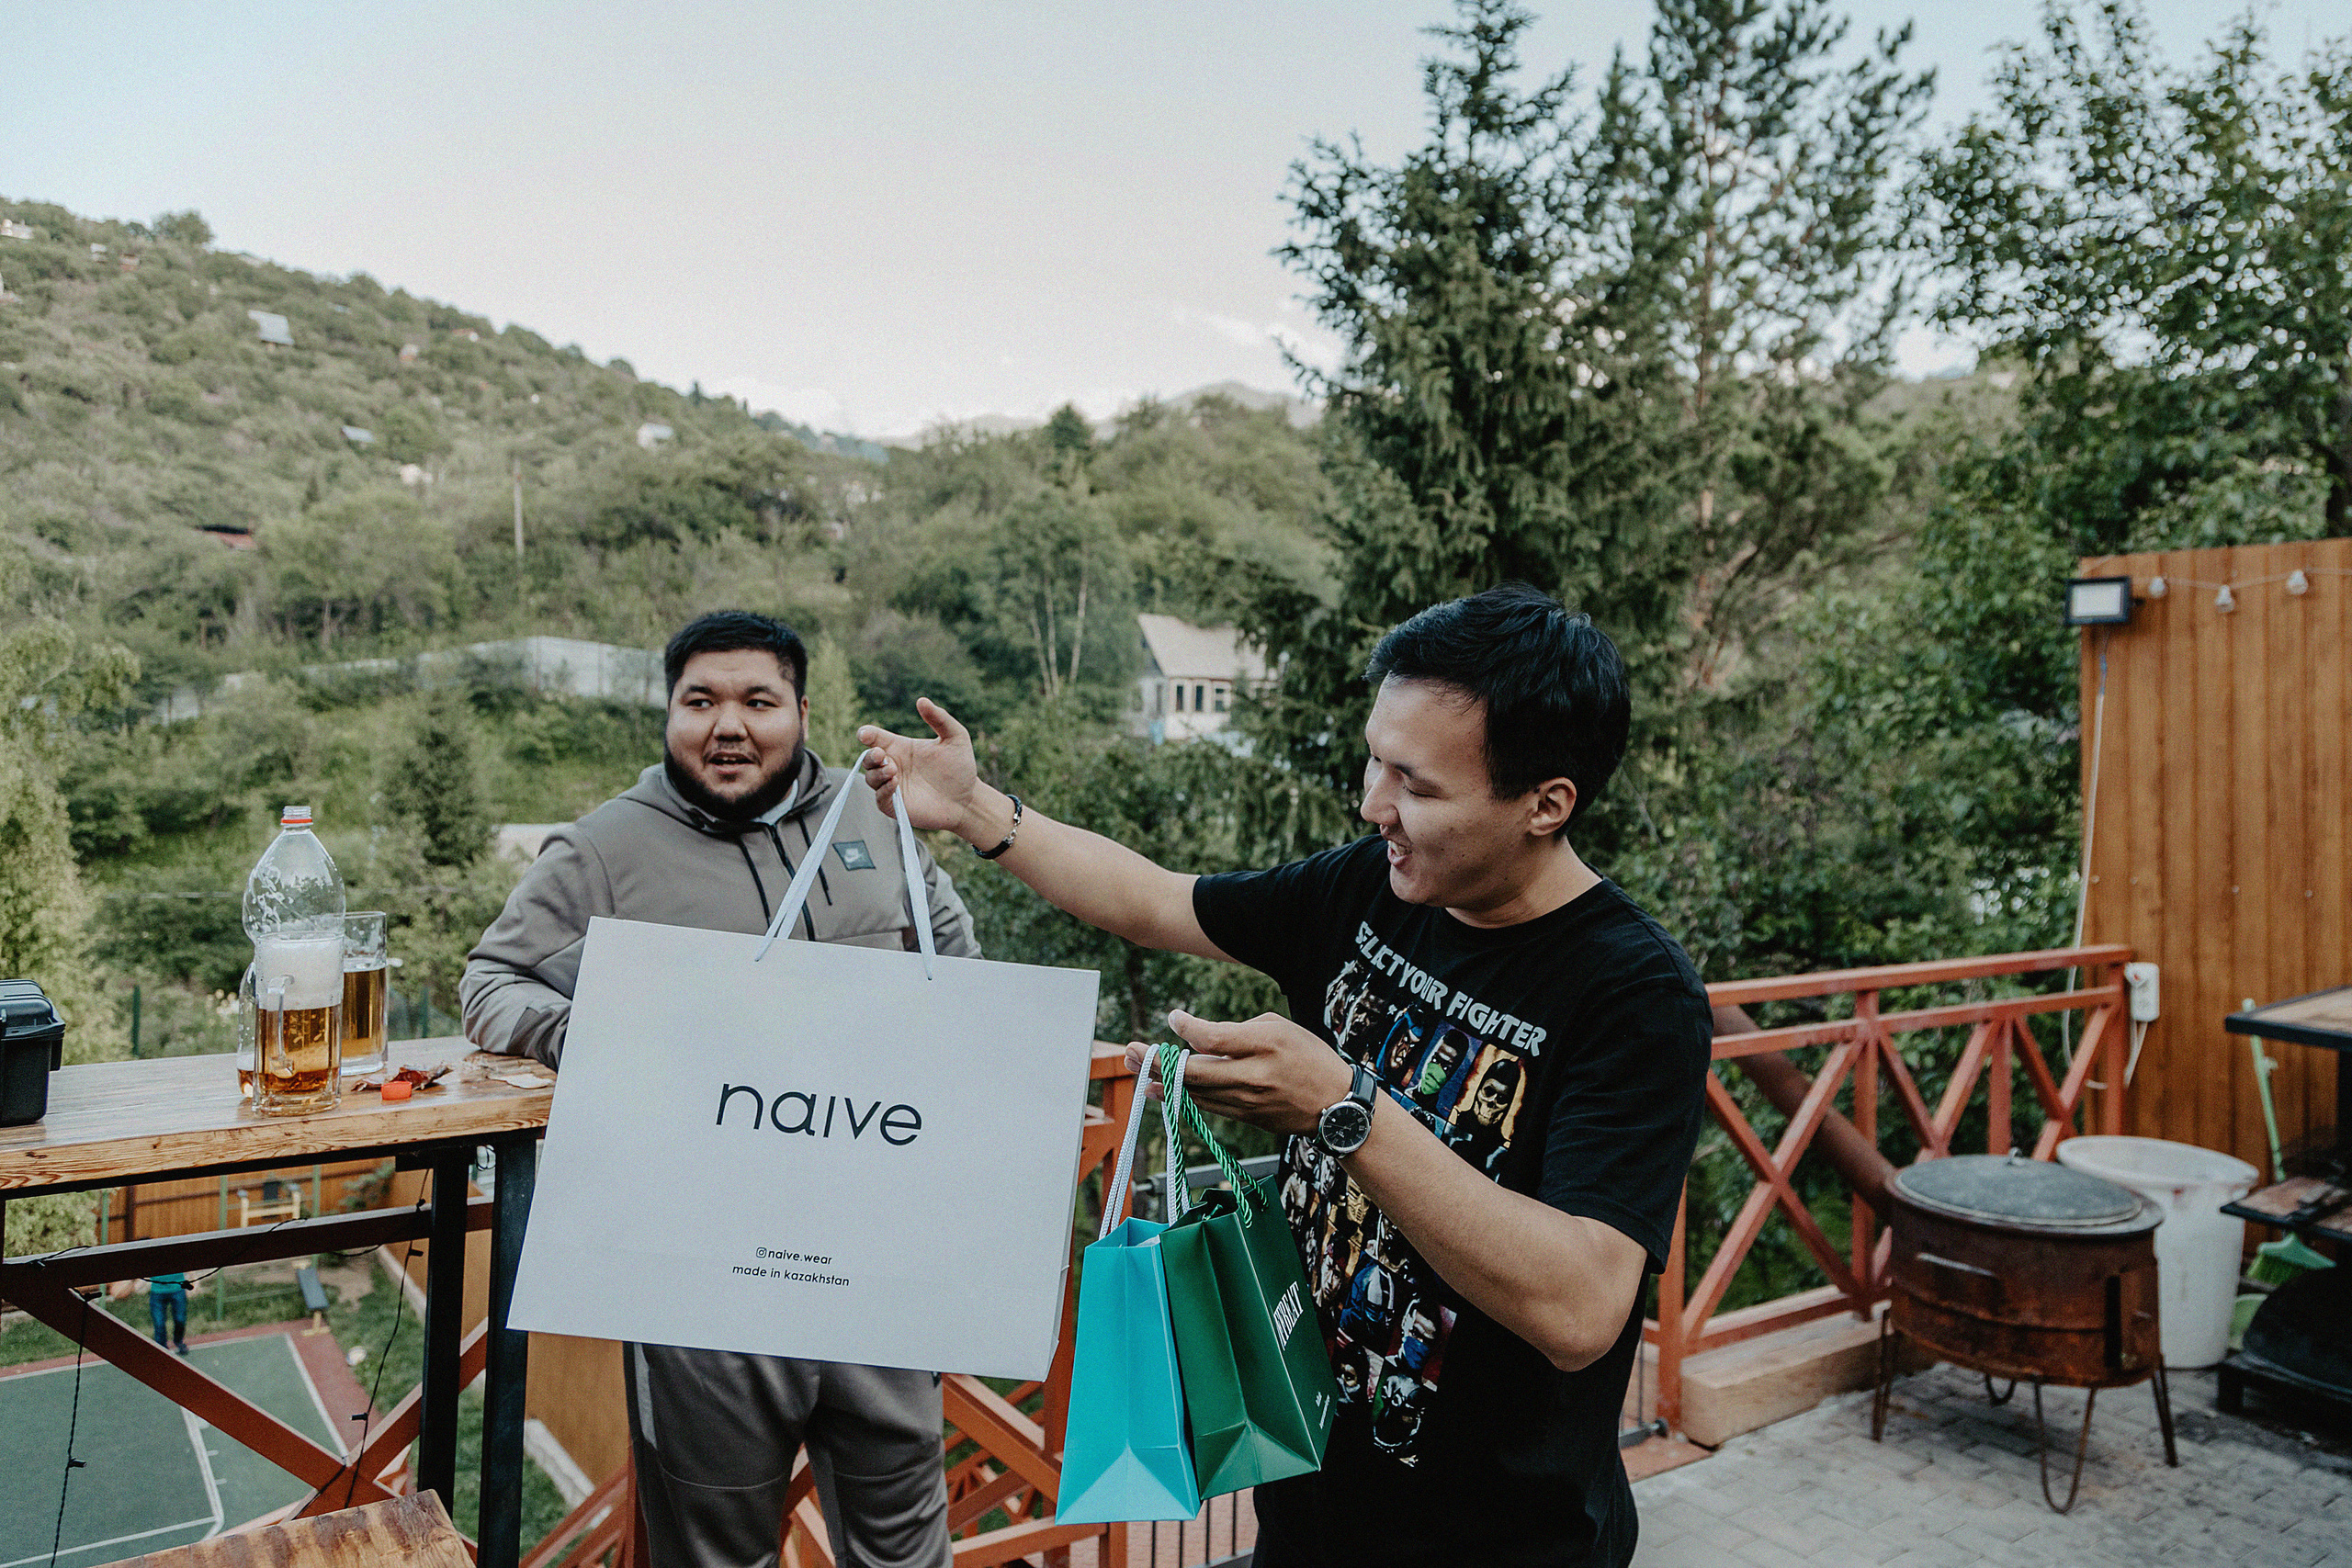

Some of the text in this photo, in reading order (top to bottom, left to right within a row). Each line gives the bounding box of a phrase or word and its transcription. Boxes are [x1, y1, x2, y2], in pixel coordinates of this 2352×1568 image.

[1354, 920, 1406, 976] SLCT
[1446, 990, 1547, 1057] FIGHTER
[768, 1249, 832, 1266] naive.wear
[732, 1265, 850, 1287] made in kazakhstan
